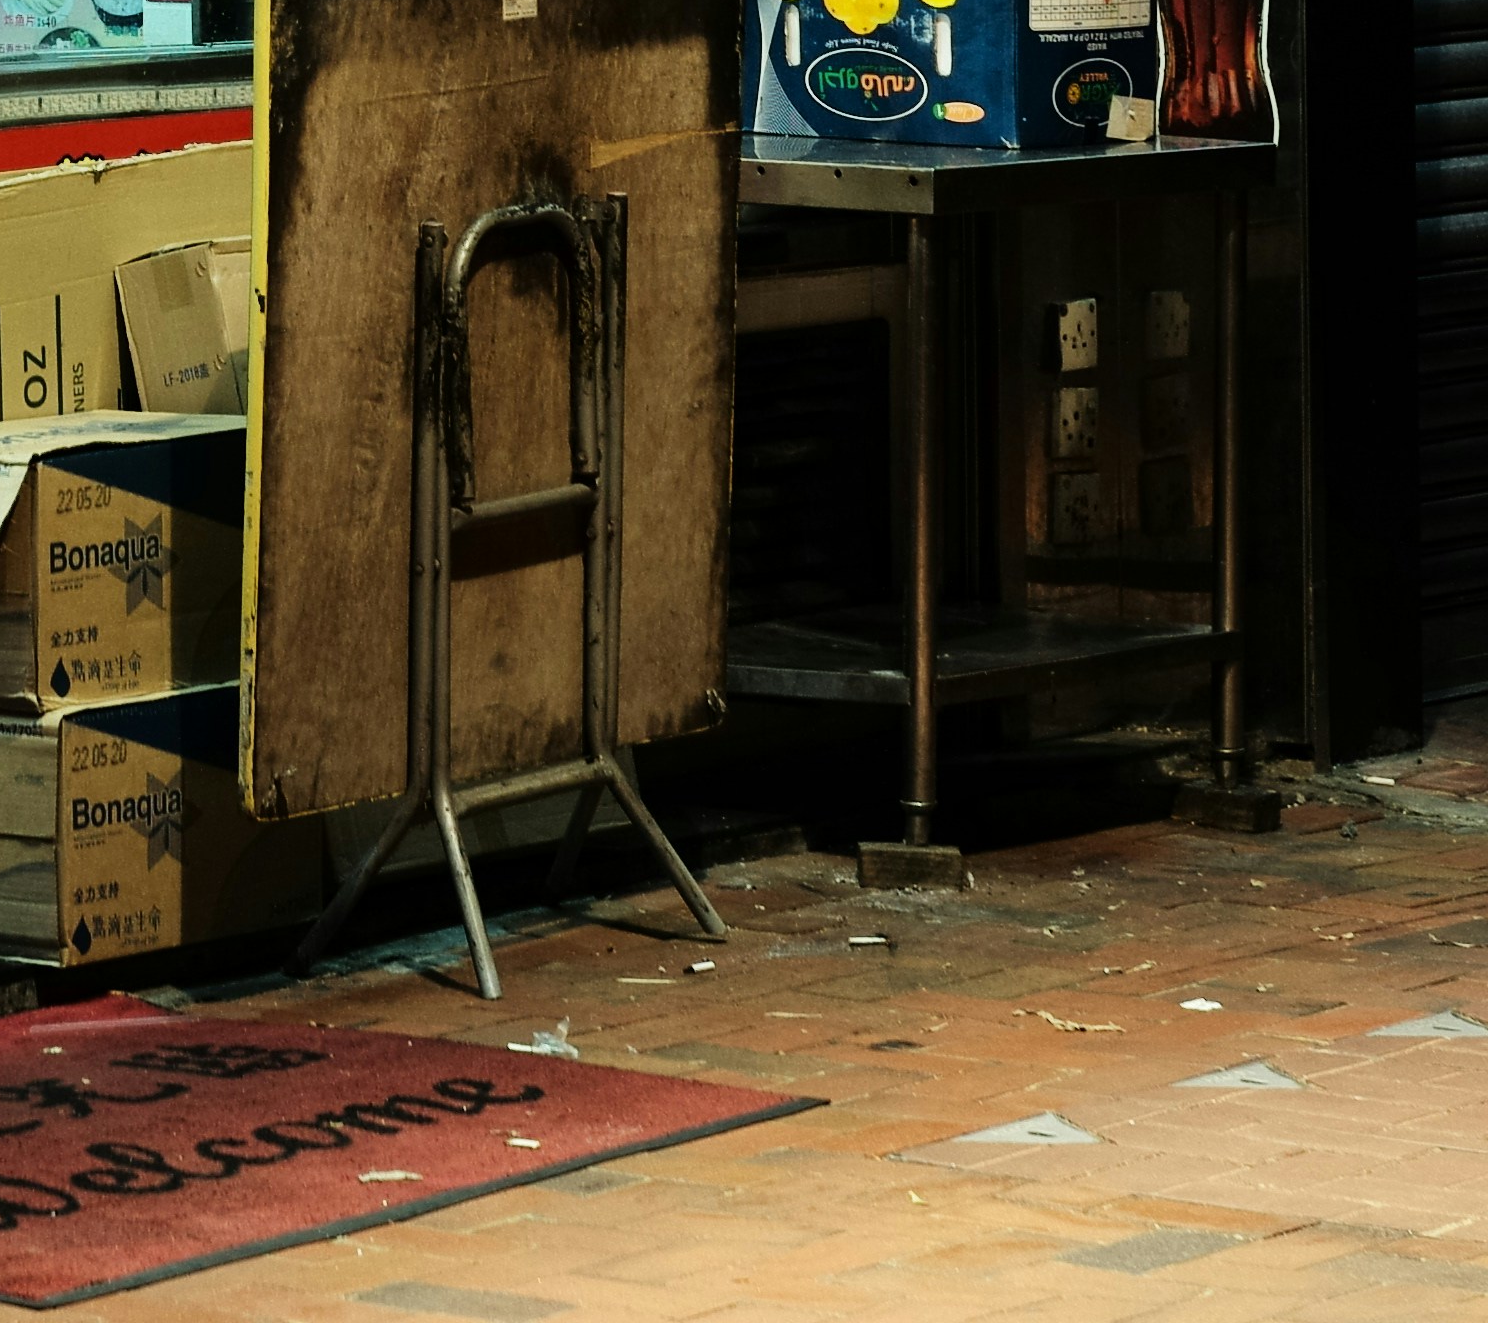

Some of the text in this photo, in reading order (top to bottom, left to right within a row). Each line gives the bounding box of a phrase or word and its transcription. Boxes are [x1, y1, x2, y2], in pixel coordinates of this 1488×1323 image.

[49, 533, 161, 574] Bonaqua
[50, 627, 98, 649] 全力支持
[72, 787, 183, 831] Bonaqua
[74, 883, 118, 904] 全力支持
